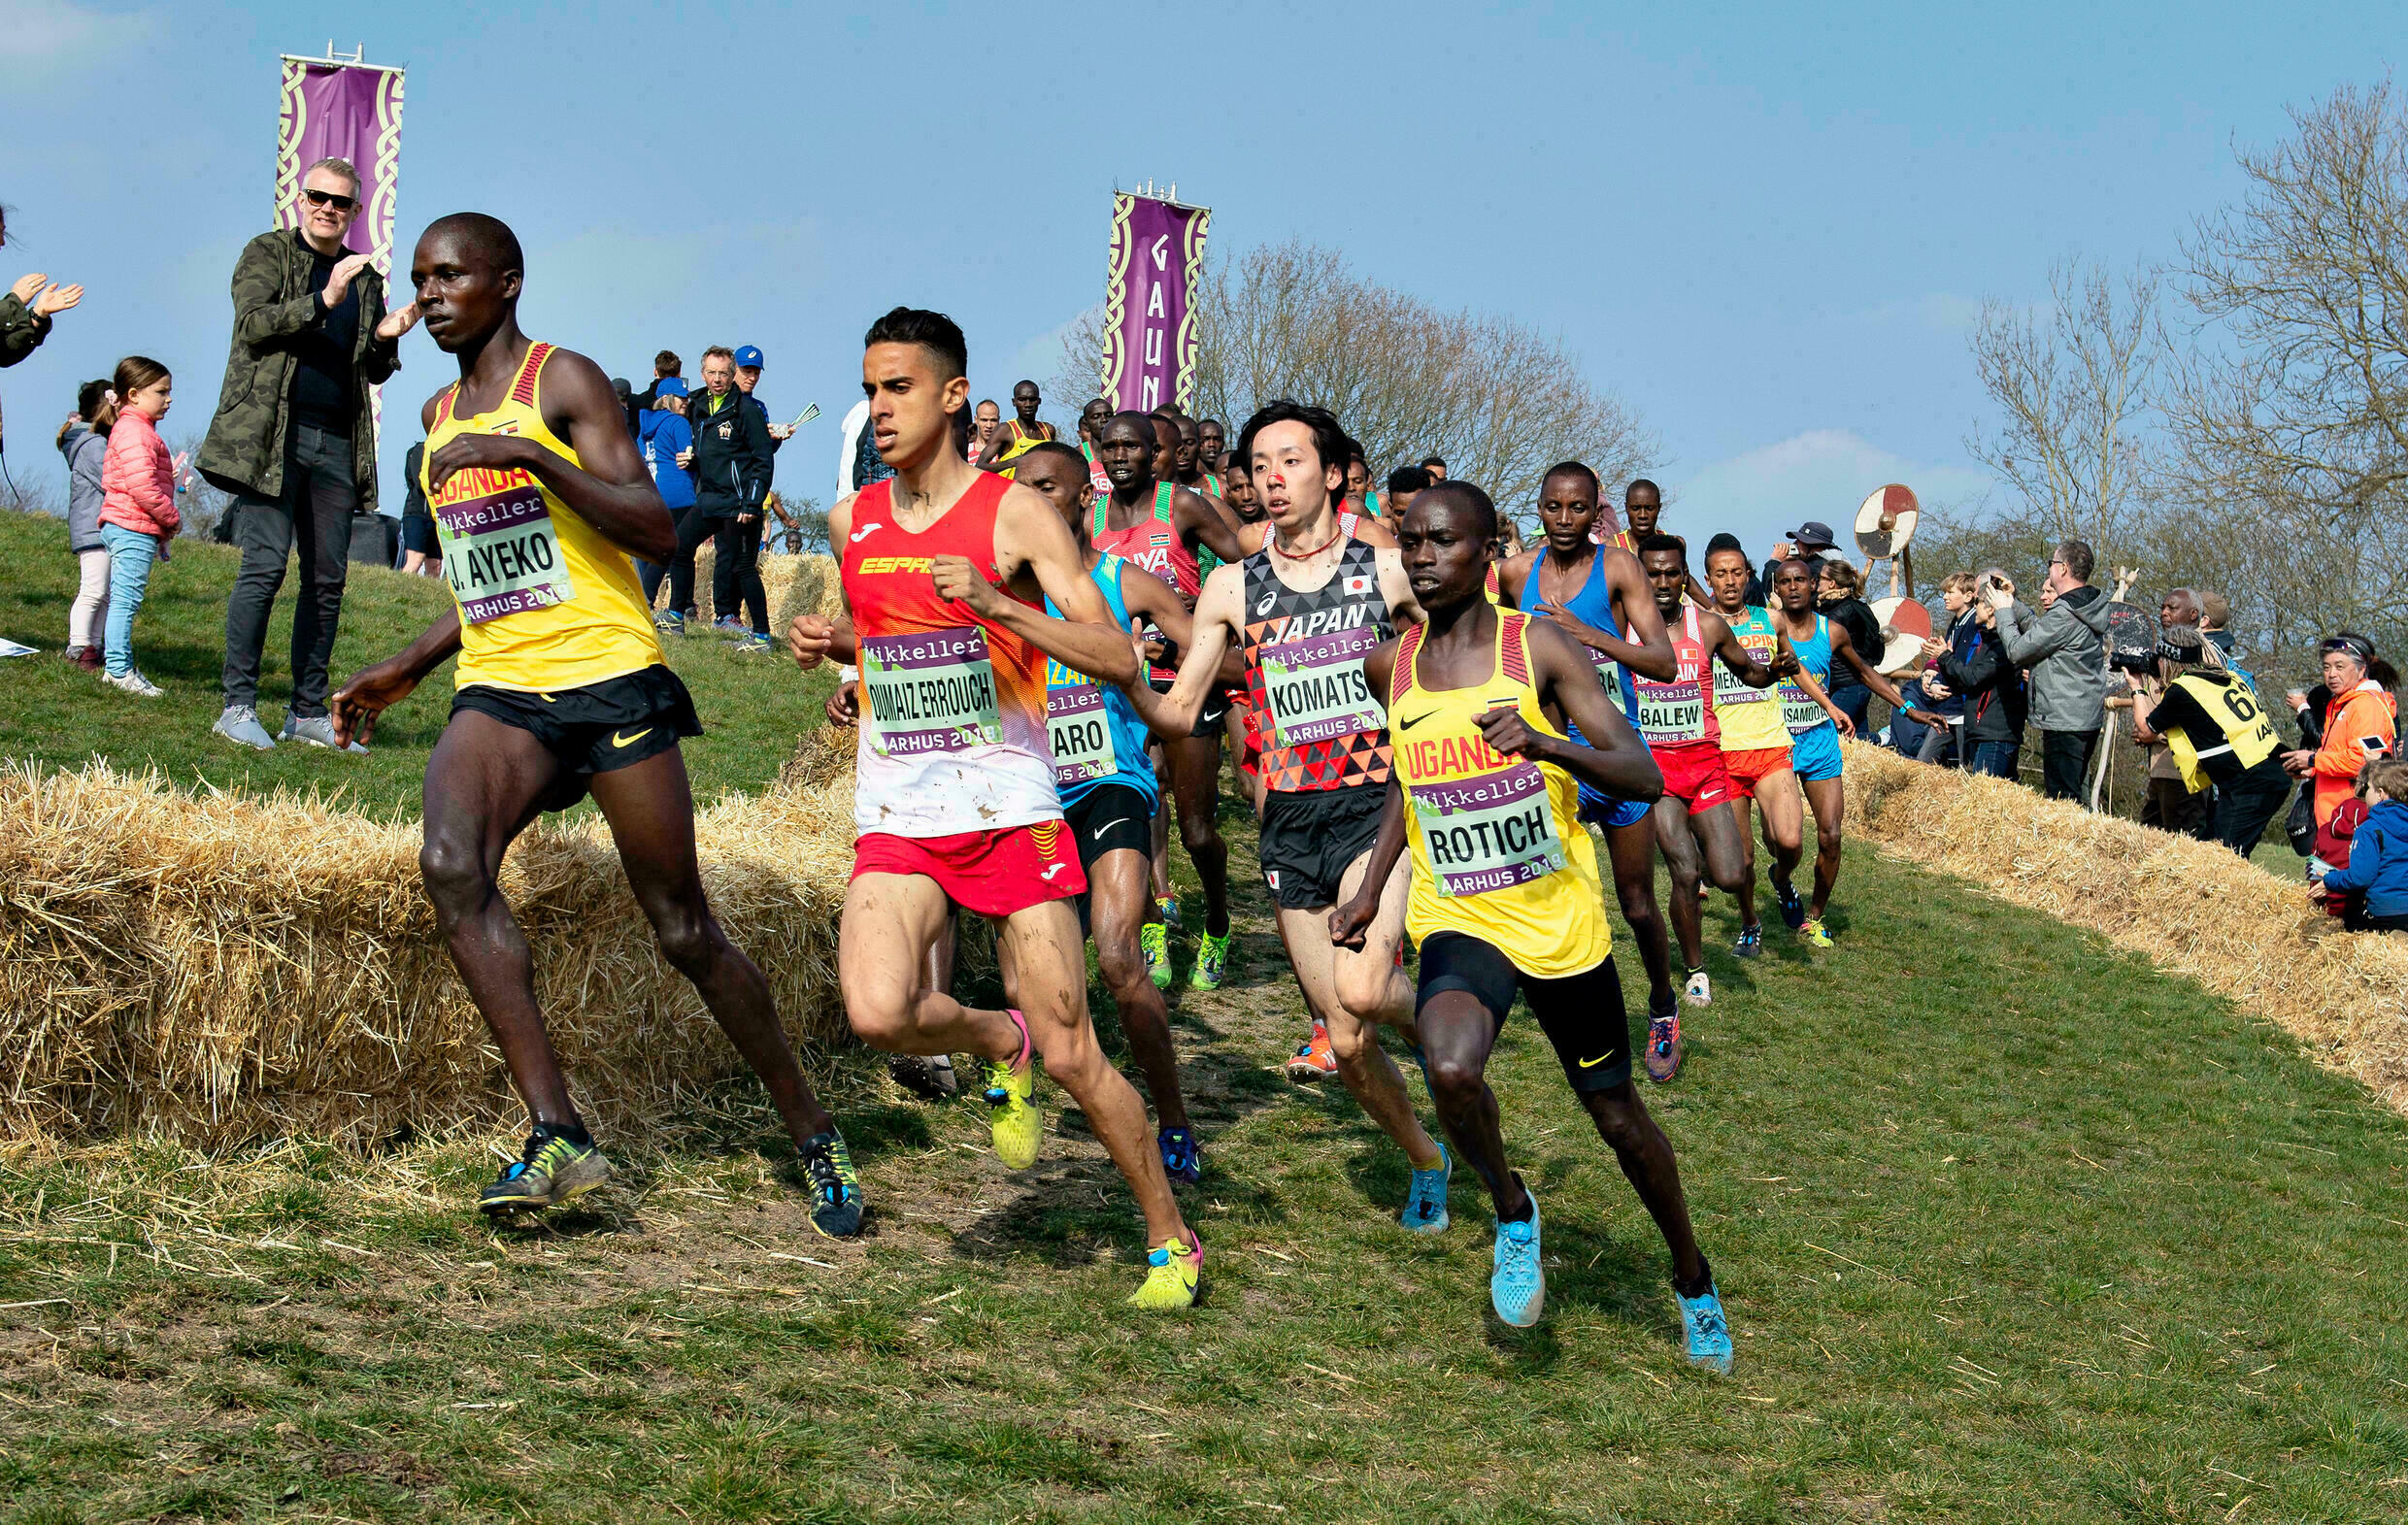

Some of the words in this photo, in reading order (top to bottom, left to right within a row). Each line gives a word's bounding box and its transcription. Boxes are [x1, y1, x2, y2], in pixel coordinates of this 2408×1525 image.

[1093, 478, 1115, 491] KEN
[436, 497, 541, 532] Mikkeller
[450, 553, 465, 591] J.
[468, 532, 554, 588] AYEKO
[858, 557, 935, 575] ESPA
[524, 583, 570, 608] 2019
[1266, 603, 1368, 646] JAPAN
[864, 638, 982, 663] Mikkeller
[1263, 637, 1375, 670] Mikkeller
[1738, 635, 1774, 648] OPIA
[869, 681, 920, 721] OUMAIZ
[918, 672, 993, 718] ERROUCH
[1048, 692, 1100, 712] eller
[1271, 669, 1368, 718] KOMATS
[1639, 688, 1699, 699] Mikkeller
[1718, 693, 1753, 704] AARHUS
[1640, 706, 1699, 727] BALEW
[875, 733, 945, 753] AARHUS
[1047, 720, 1104, 757] ARO
[1283, 720, 1347, 744] AARHUS
[1416, 771, 1540, 810] Mikkeller
[1428, 805, 1550, 865] ROTICH
[1441, 871, 1516, 894] AARHUS
[1520, 853, 1562, 880] 2019
